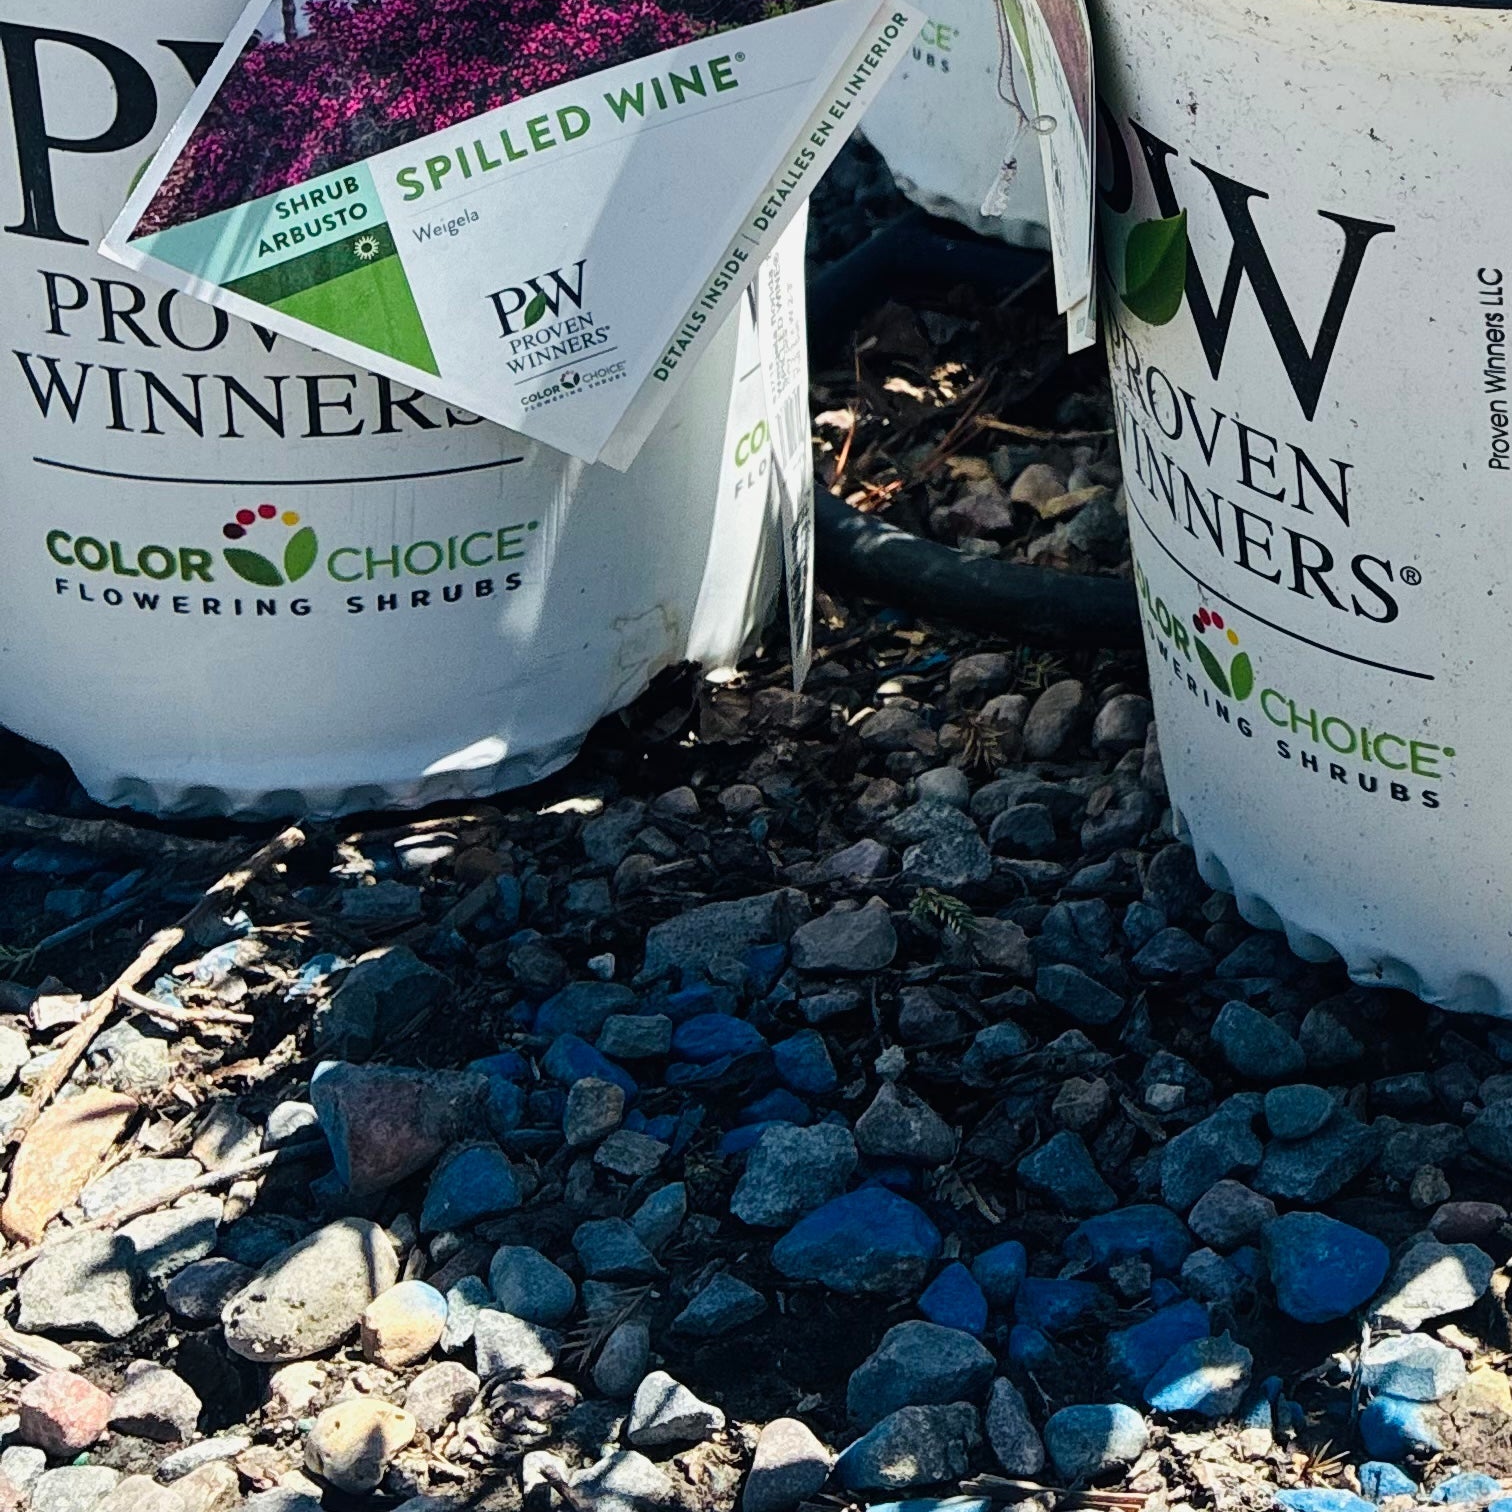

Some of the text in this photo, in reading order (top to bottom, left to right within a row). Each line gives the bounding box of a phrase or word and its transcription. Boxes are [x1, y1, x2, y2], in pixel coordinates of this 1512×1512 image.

[0, 21, 224, 246] P
[396, 105, 591, 202] SPILLED
[275, 175, 360, 220] SHRUB
[412, 207, 480, 244] Weigela
[653, 11, 909, 383] DETAILS INSIDE DETALLES EN EL INTERIOR
[257, 201, 368, 258] ARBUSTO
[37, 269, 278, 353] PRO
[485, 258, 587, 338] PW
[509, 311, 595, 355] PROVEN
[520, 382, 561, 406] COLOR
[1477, 267, 1510, 470] Proven Winners LLC
[45, 529, 215, 583] COLOR
[56, 571, 524, 616] FLOWERING SHRUBS
[1276, 739, 1441, 809] SHRUBS
